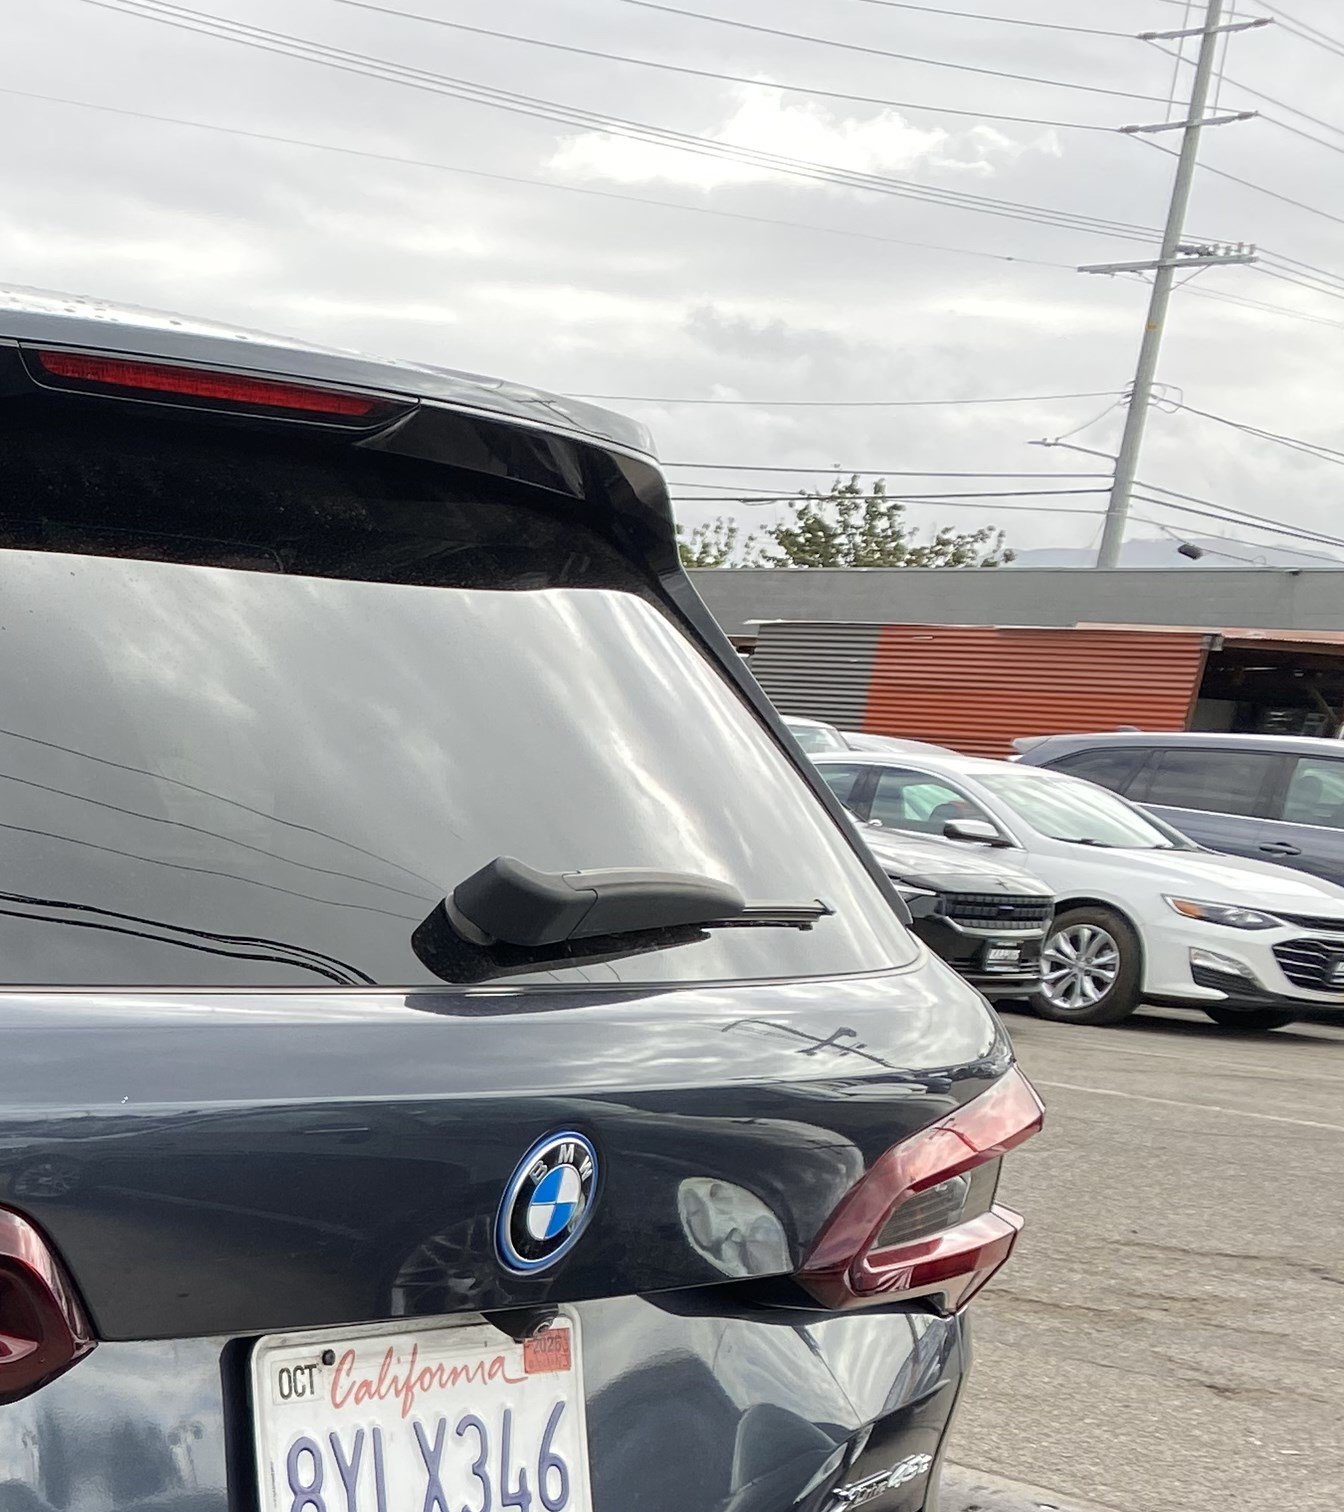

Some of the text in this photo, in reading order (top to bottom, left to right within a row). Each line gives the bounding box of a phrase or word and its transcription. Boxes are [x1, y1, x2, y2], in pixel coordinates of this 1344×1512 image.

[529, 1143, 593, 1185] BMW
[278, 1362, 318, 1400] OCT
[330, 1343, 529, 1419] California
